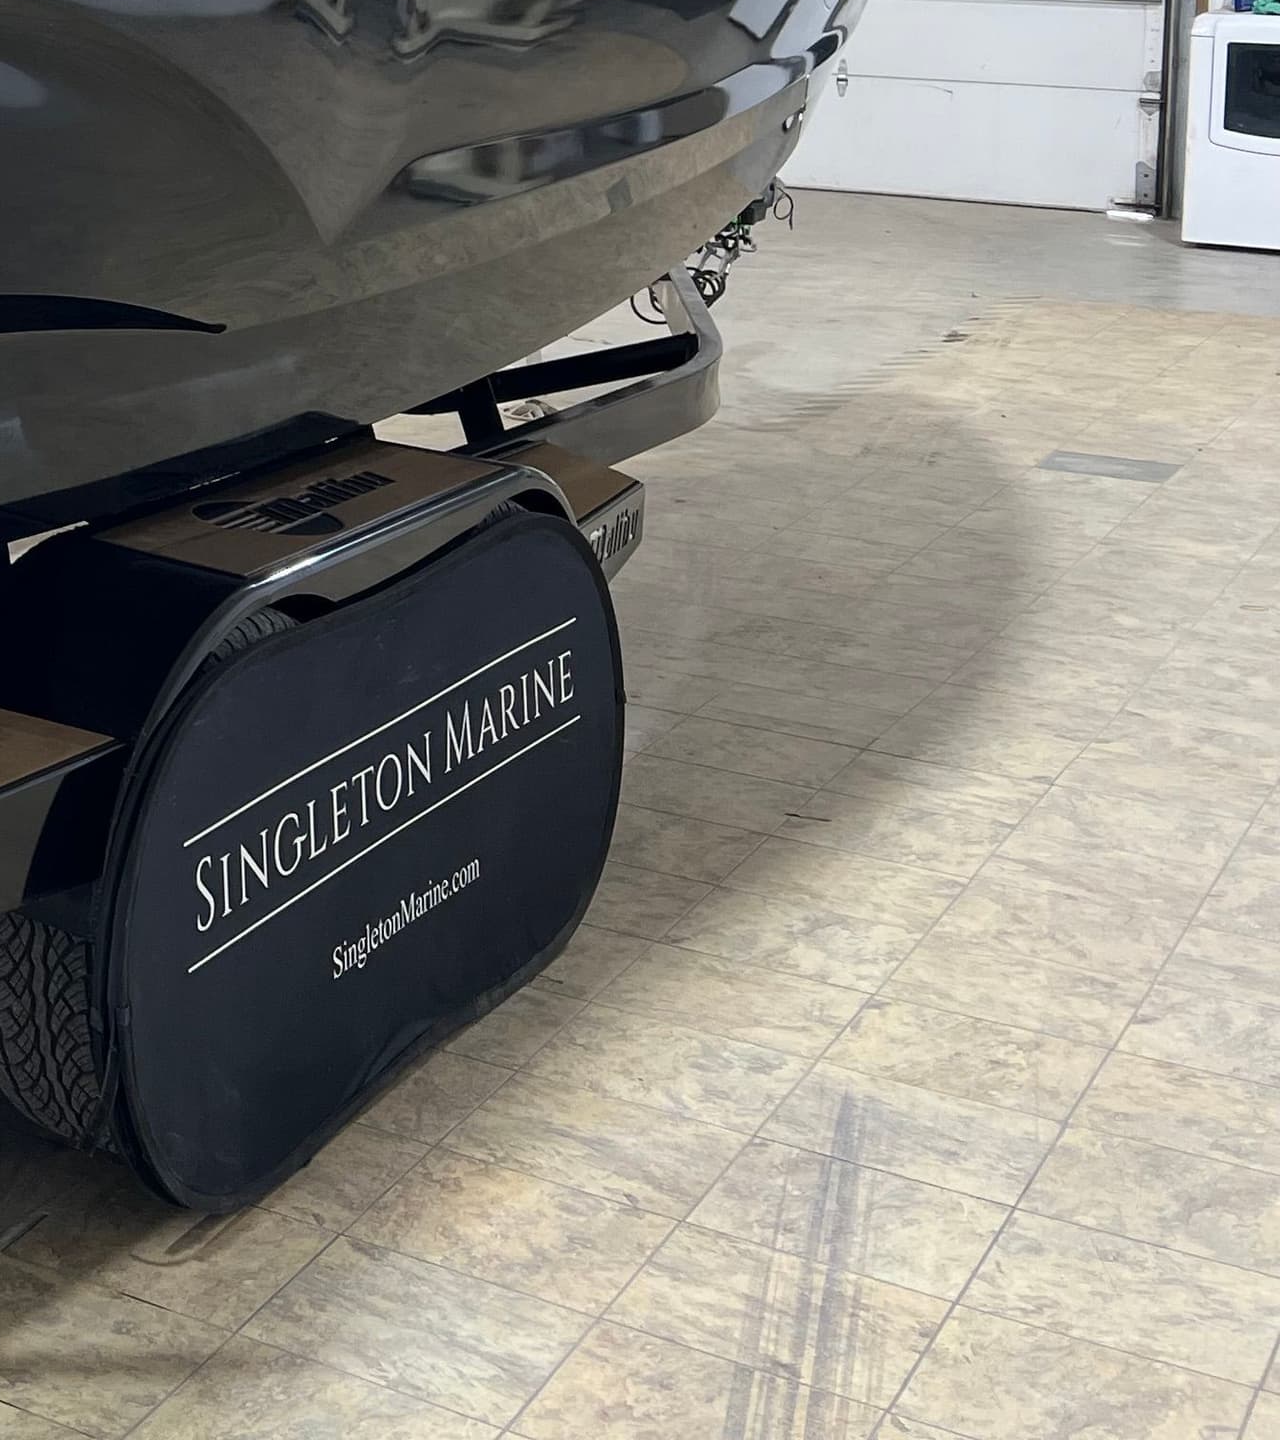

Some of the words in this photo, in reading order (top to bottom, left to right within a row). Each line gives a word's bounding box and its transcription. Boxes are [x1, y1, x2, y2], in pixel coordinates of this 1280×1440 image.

[196, 731, 433, 934] SINGLETON
[443, 650, 576, 775] MARINE
[332, 856, 480, 980] SingletonMarine.com
